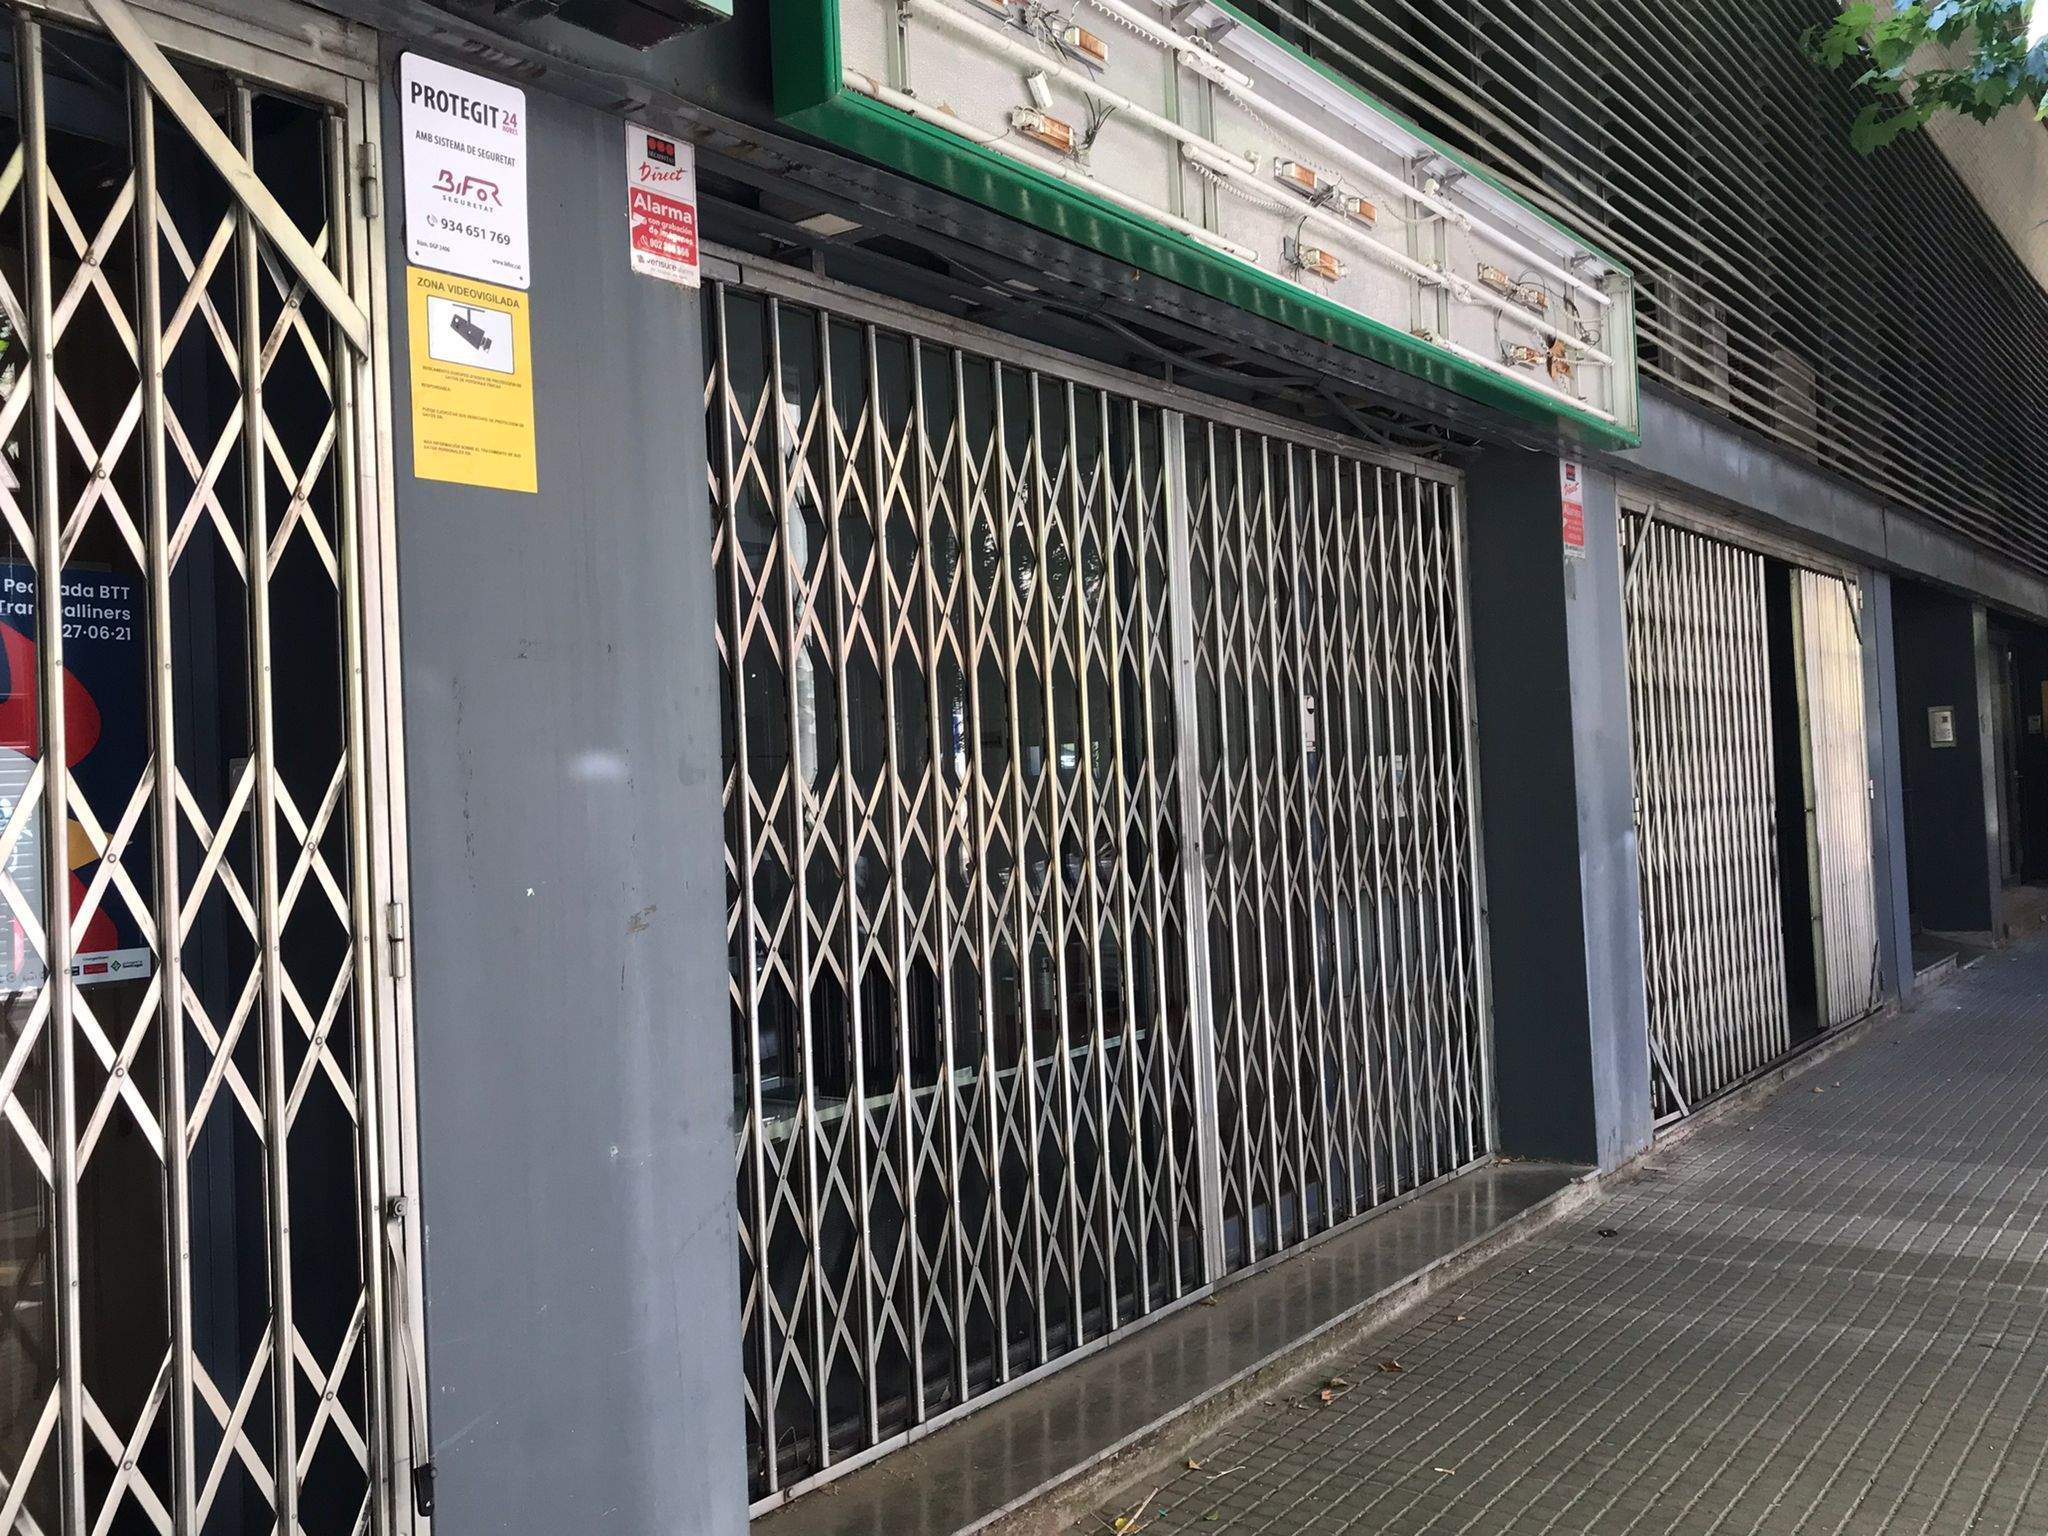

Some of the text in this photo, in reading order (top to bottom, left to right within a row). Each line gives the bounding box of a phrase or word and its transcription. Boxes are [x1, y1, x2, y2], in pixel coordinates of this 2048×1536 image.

[411, 81, 518, 128] PROTEGIT 24
[415, 130, 515, 168] AMB SISTEMA DE SEGURETAT
[638, 161, 687, 182] Direct
[443, 194, 494, 213] SEGURETAT
[633, 192, 692, 224] Alarma
[441, 218, 511, 246] 934 651 769
[417, 277, 520, 309] ZONA VIDEOVIGILADA
[99, 585, 130, 600] BTT
